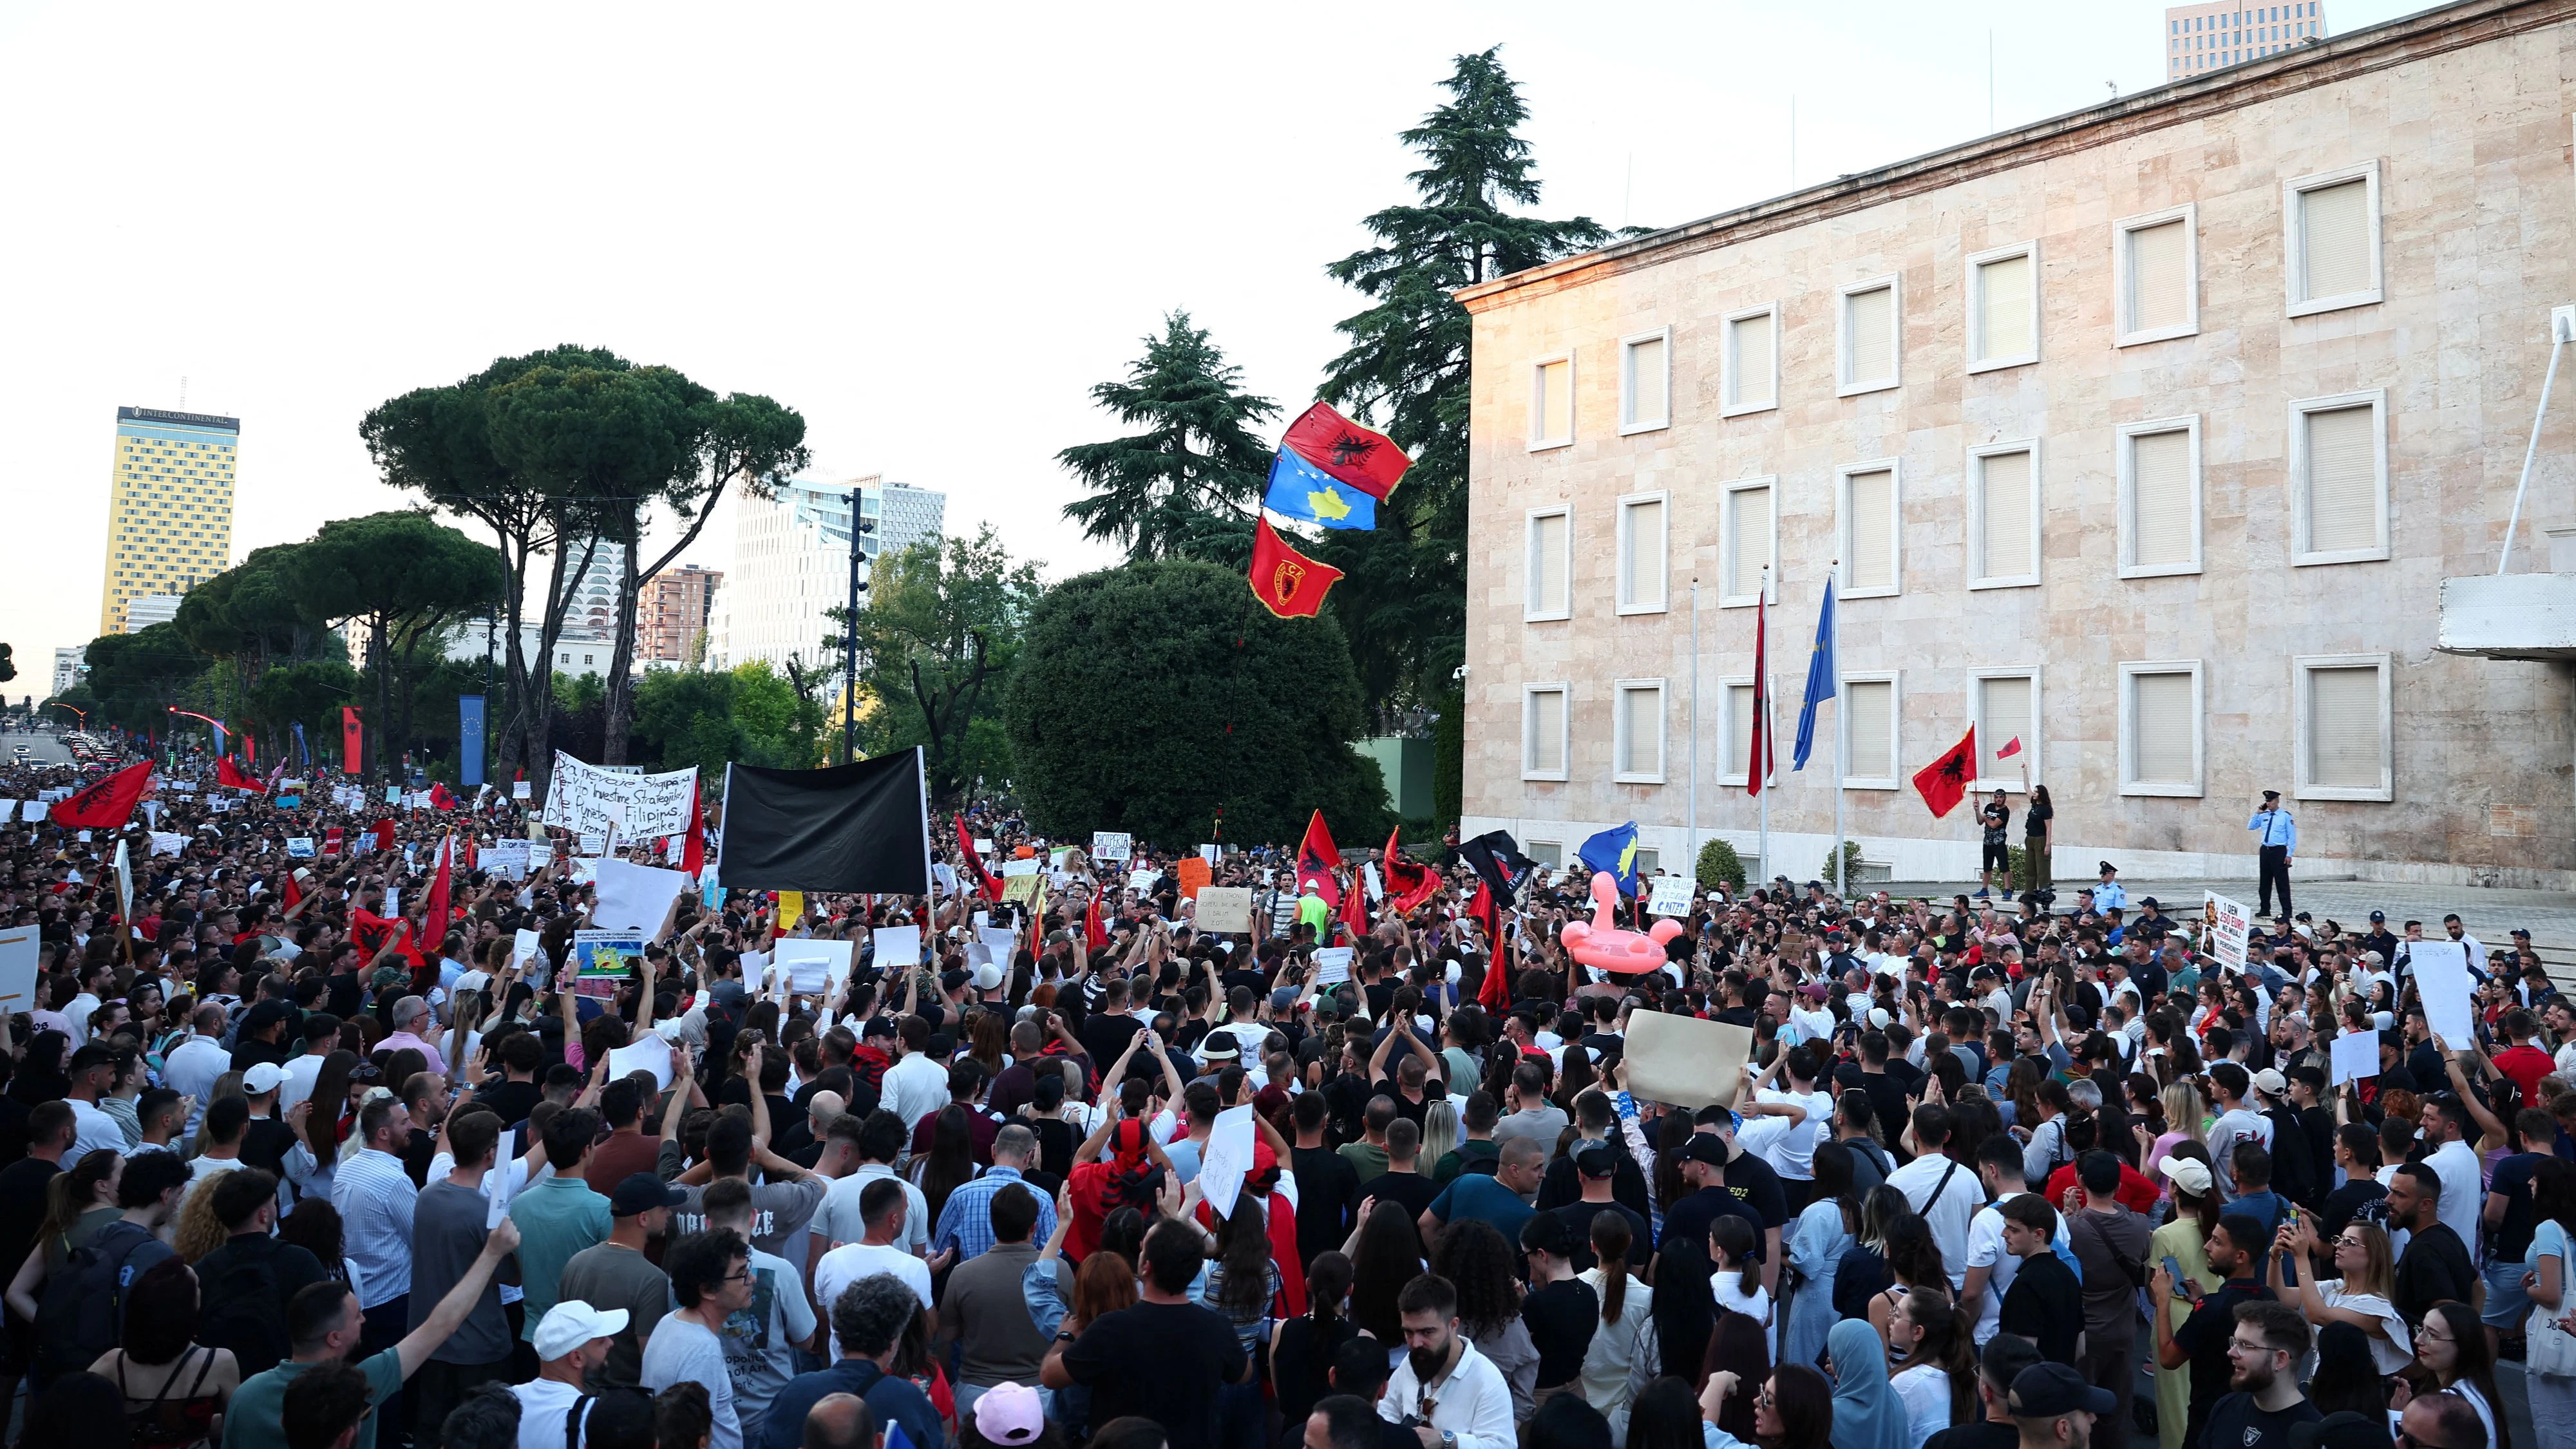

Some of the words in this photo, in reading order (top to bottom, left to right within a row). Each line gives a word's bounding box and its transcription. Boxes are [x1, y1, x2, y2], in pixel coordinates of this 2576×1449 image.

[143, 408, 226, 424] INTERCONTINENTAL
[550, 787, 571, 809] Me
[1095, 834, 1128, 848] SHQIPERIA
[1097, 847, 1108, 857] NUK
[1109, 847, 1126, 858] SHITET
[2228, 904, 2238, 916] QEN
[2220, 911, 2230, 925] 250
[2231, 916, 2245, 931] EURO
[734, 1365, 745, 1377] of
[748, 1364, 768, 1374] Art
